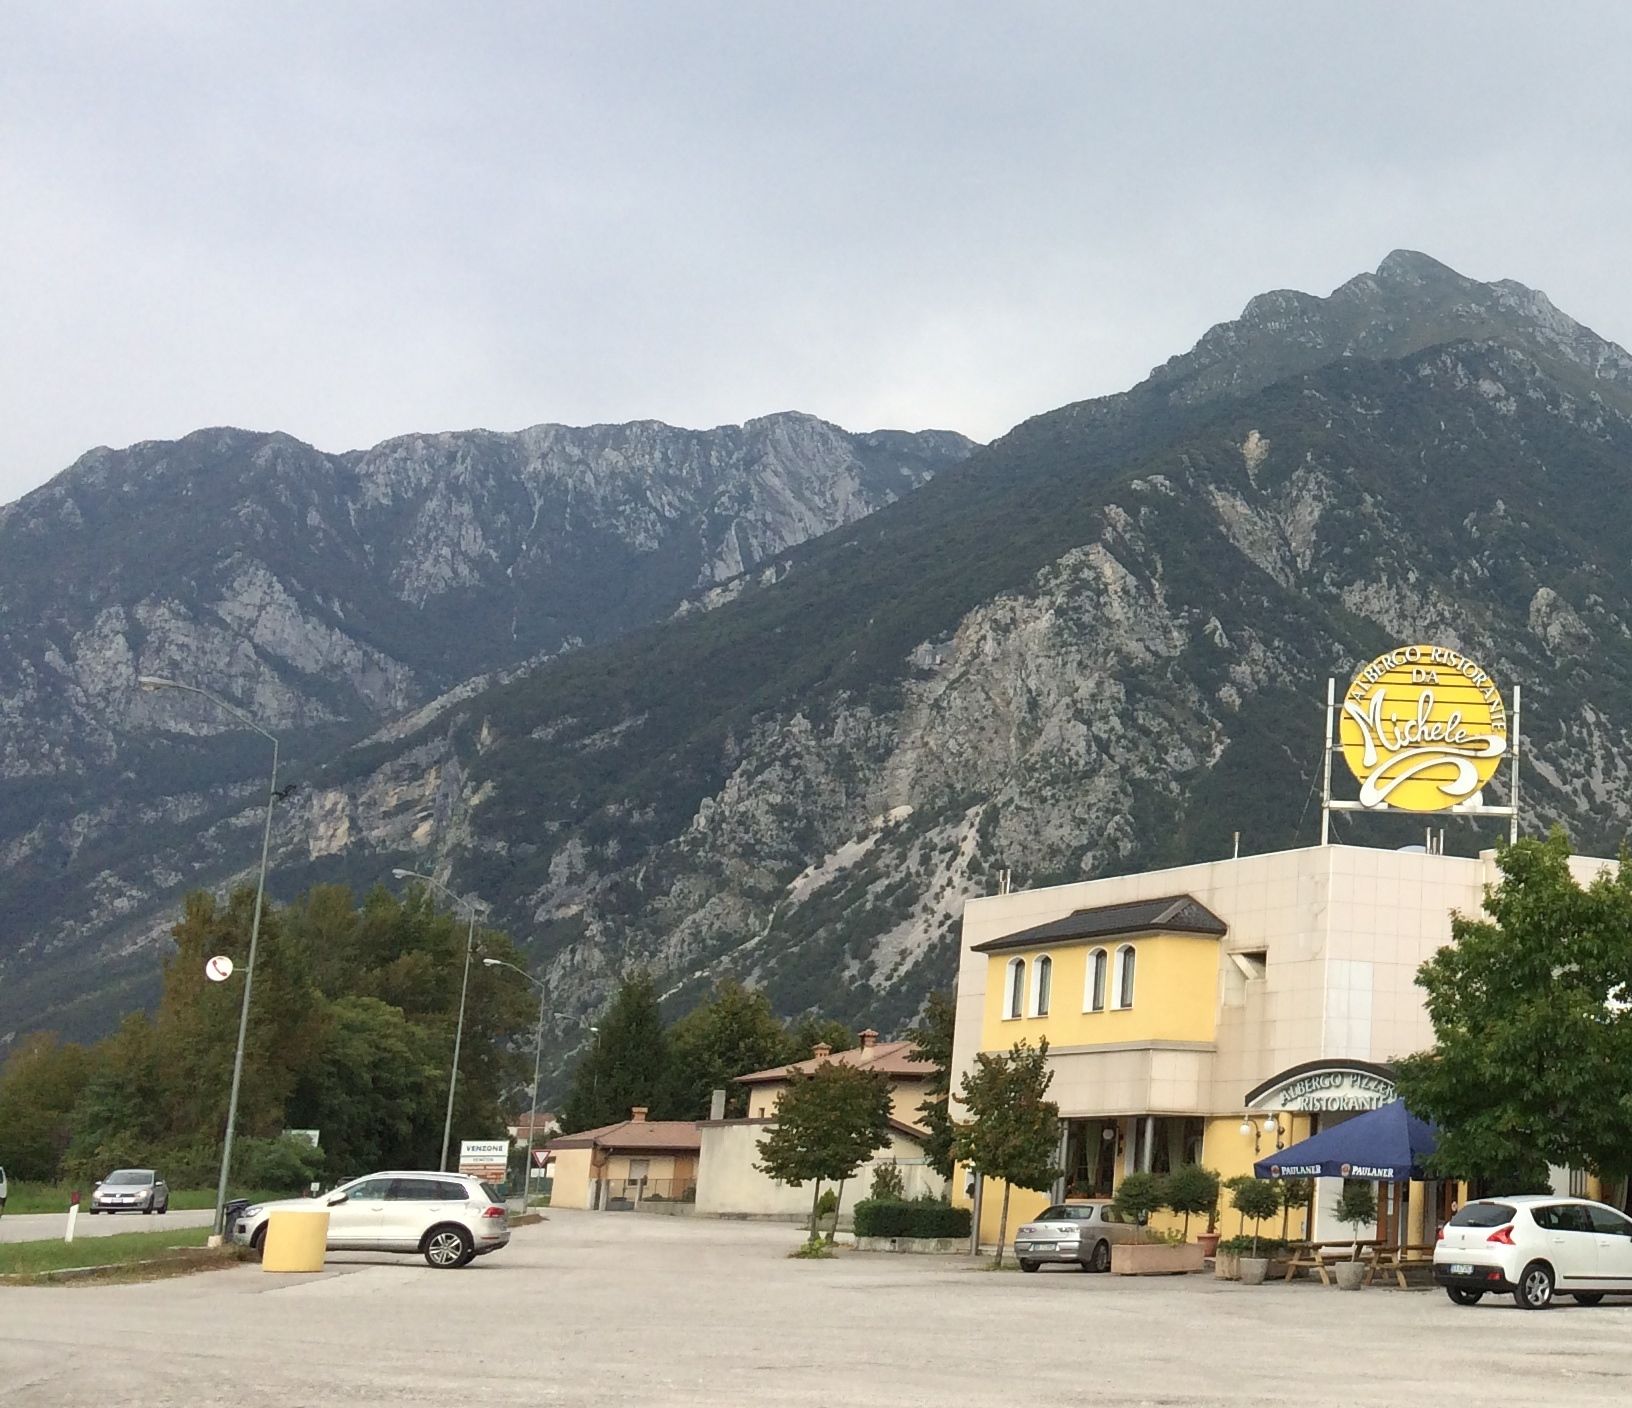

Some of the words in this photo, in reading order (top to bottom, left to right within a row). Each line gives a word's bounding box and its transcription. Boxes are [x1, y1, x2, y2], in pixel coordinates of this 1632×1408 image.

[1412, 667, 1439, 684] DA
[1350, 647, 1421, 704] ALBERGO
[1430, 647, 1506, 731] RISTORANTE
[1344, 688, 1506, 768] Michele
[1280, 1073, 1343, 1106] ALBERGO
[1281, 1164, 1321, 1175] PAULANER
[1352, 1165, 1394, 1178] PAULANER
